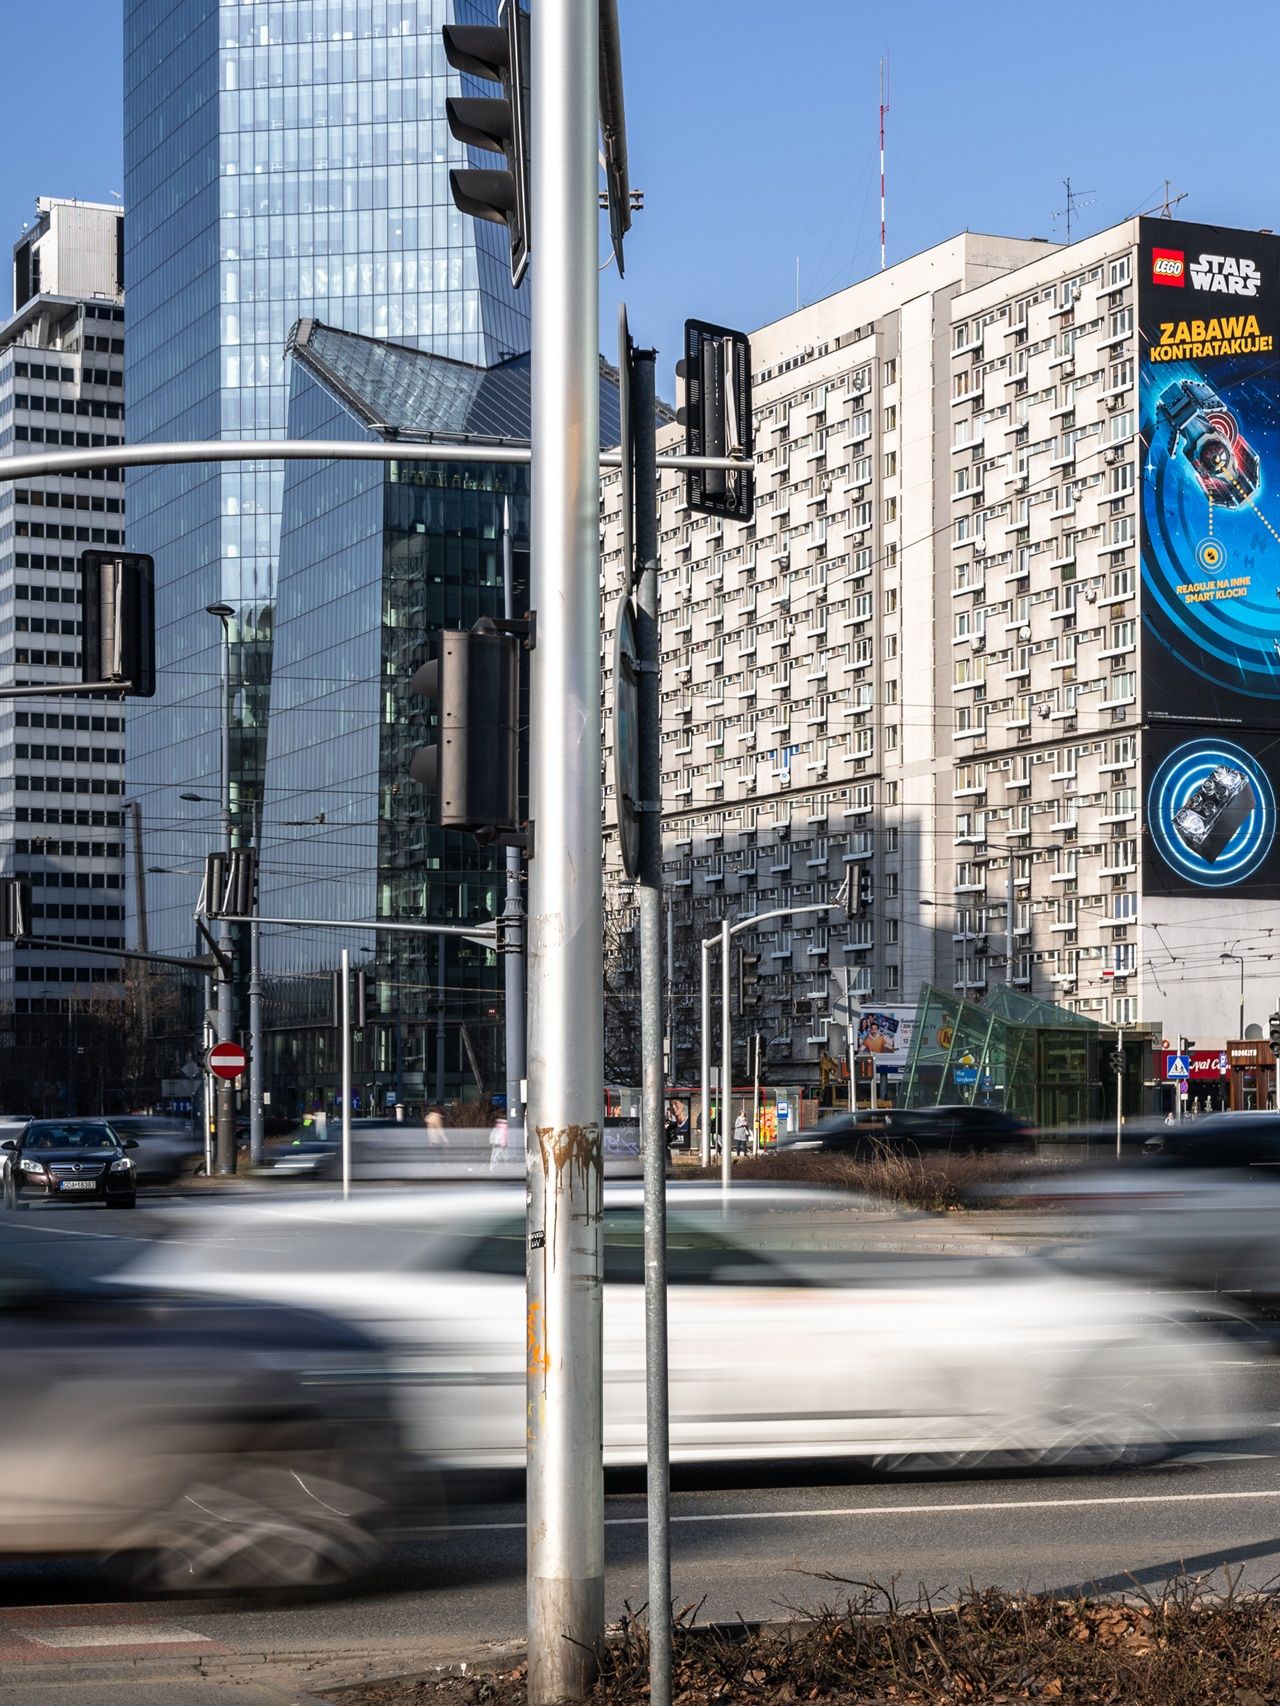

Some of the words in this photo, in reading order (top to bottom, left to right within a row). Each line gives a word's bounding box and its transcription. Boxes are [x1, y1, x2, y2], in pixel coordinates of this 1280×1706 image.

[1155, 260, 1182, 275] LEGO
[1189, 254, 1261, 279] STAR
[1190, 271, 1261, 297] WARS
[1160, 315, 1260, 345] ZABAWA
[1150, 336, 1273, 362] KONTRATAKUJE!
[1176, 581, 1216, 595] REAGUJE
[1217, 579, 1230, 589] NA
[1230, 576, 1252, 587] INNE
[1185, 591, 1215, 604] SMART
[1216, 587, 1248, 599] KLOCKI
